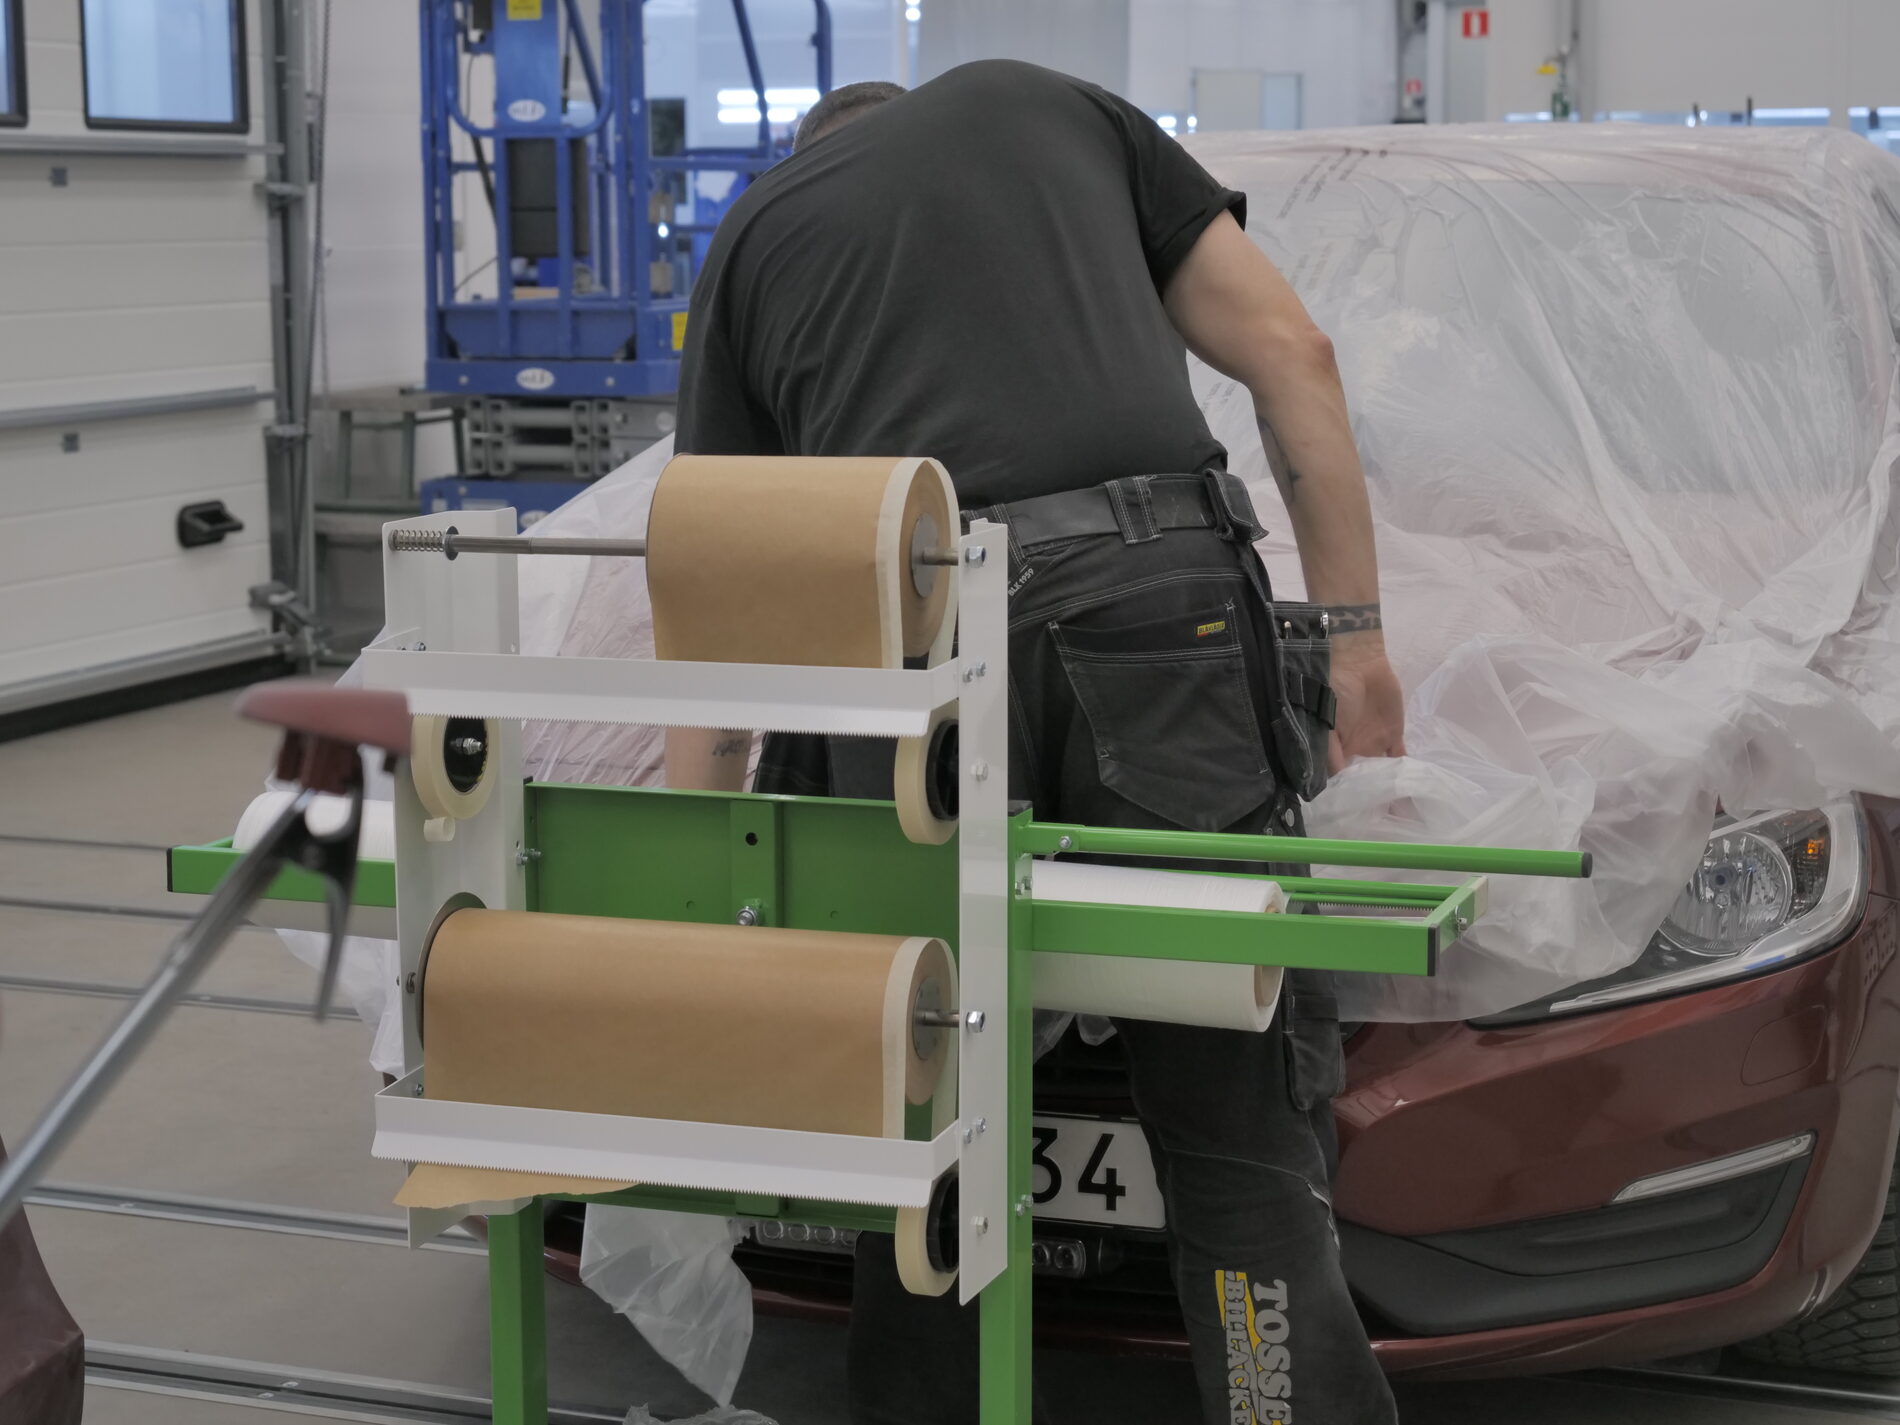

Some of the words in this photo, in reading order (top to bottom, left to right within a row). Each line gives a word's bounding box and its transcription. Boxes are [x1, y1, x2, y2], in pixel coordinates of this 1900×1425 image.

[1008, 581, 1022, 597] BLK
[1019, 568, 1034, 584] 1959
[1253, 1279, 1293, 1425] TOSSE
